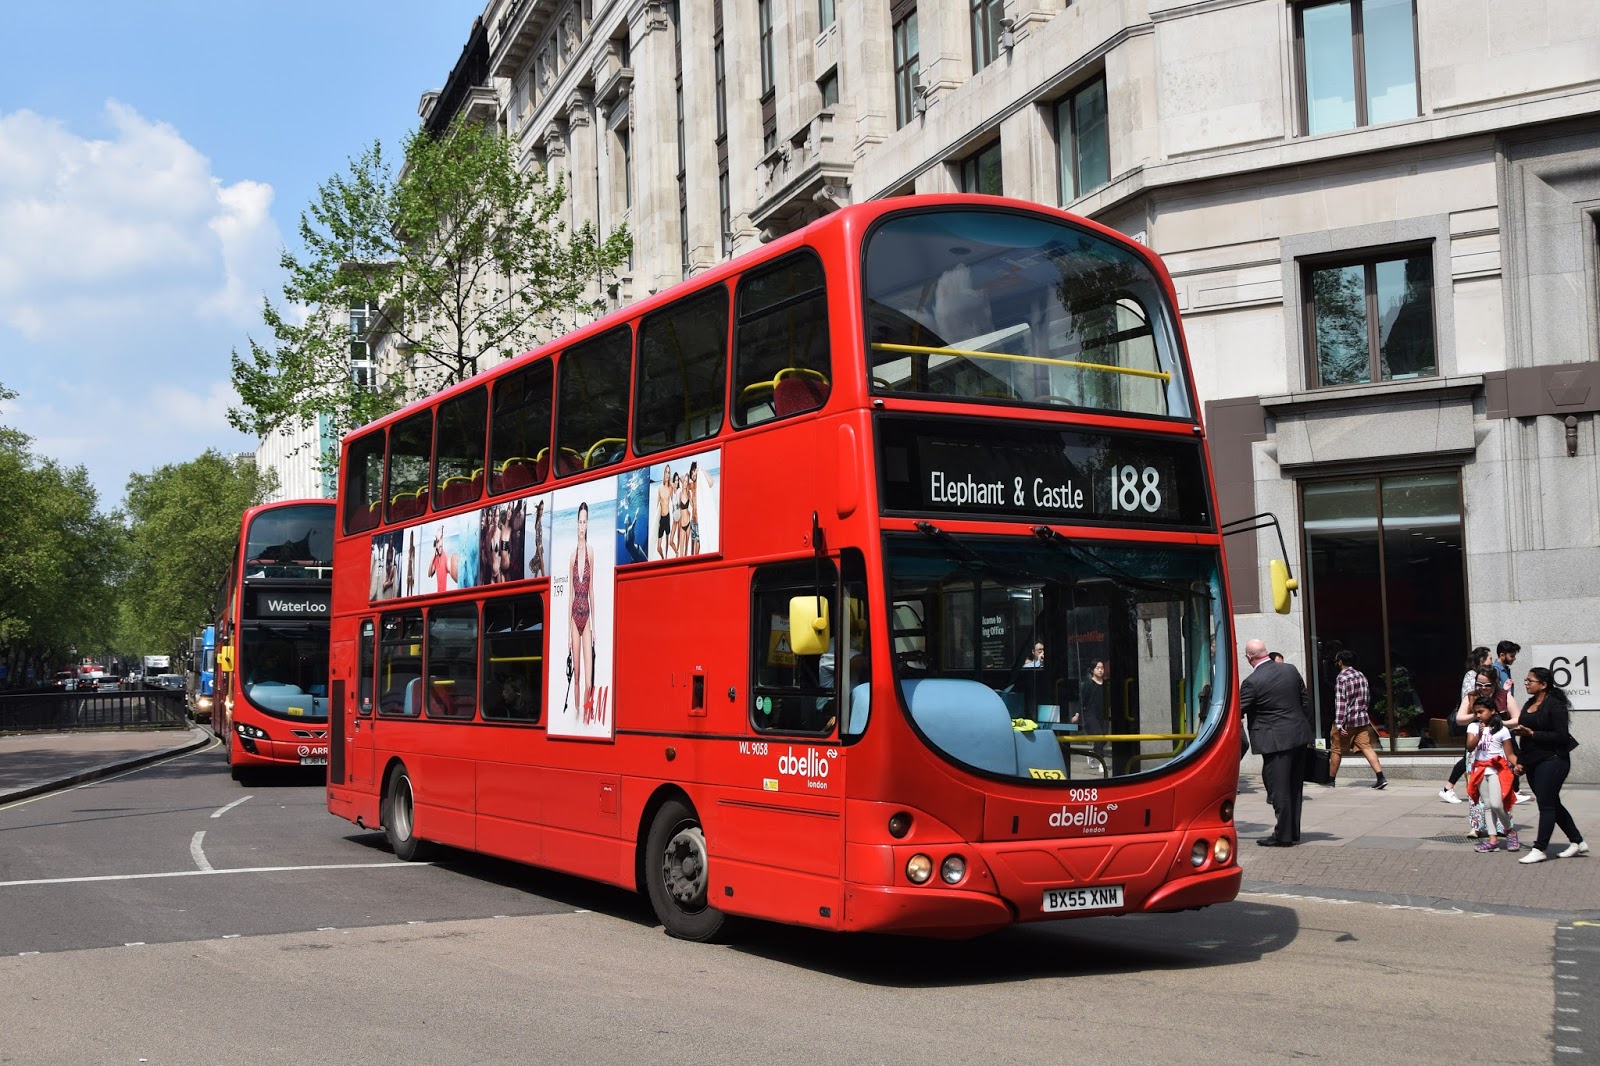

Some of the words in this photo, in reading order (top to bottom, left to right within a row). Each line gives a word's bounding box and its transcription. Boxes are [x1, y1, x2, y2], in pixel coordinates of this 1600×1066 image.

[931, 471, 1004, 506] Elephant
[1013, 476, 1025, 506] &
[1033, 477, 1084, 509] Castle
[1111, 464, 1162, 512] 188
[268, 600, 327, 612] Waterloo
[990, 625, 1005, 636] Office
[1549, 655, 1589, 688] 61
[583, 685, 609, 727] H&M
[311, 747, 328, 755] ARR
[739, 741, 750, 755] WL
[752, 742, 768, 756] 9058
[778, 746, 829, 778] abellio
[807, 779, 828, 790] london
[1069, 788, 1098, 802] 9058
[1048, 804, 1109, 827] abellio
[1082, 826, 1106, 834] london
[1049, 890, 1086, 909] BX55
[1090, 888, 1118, 906] XNM
